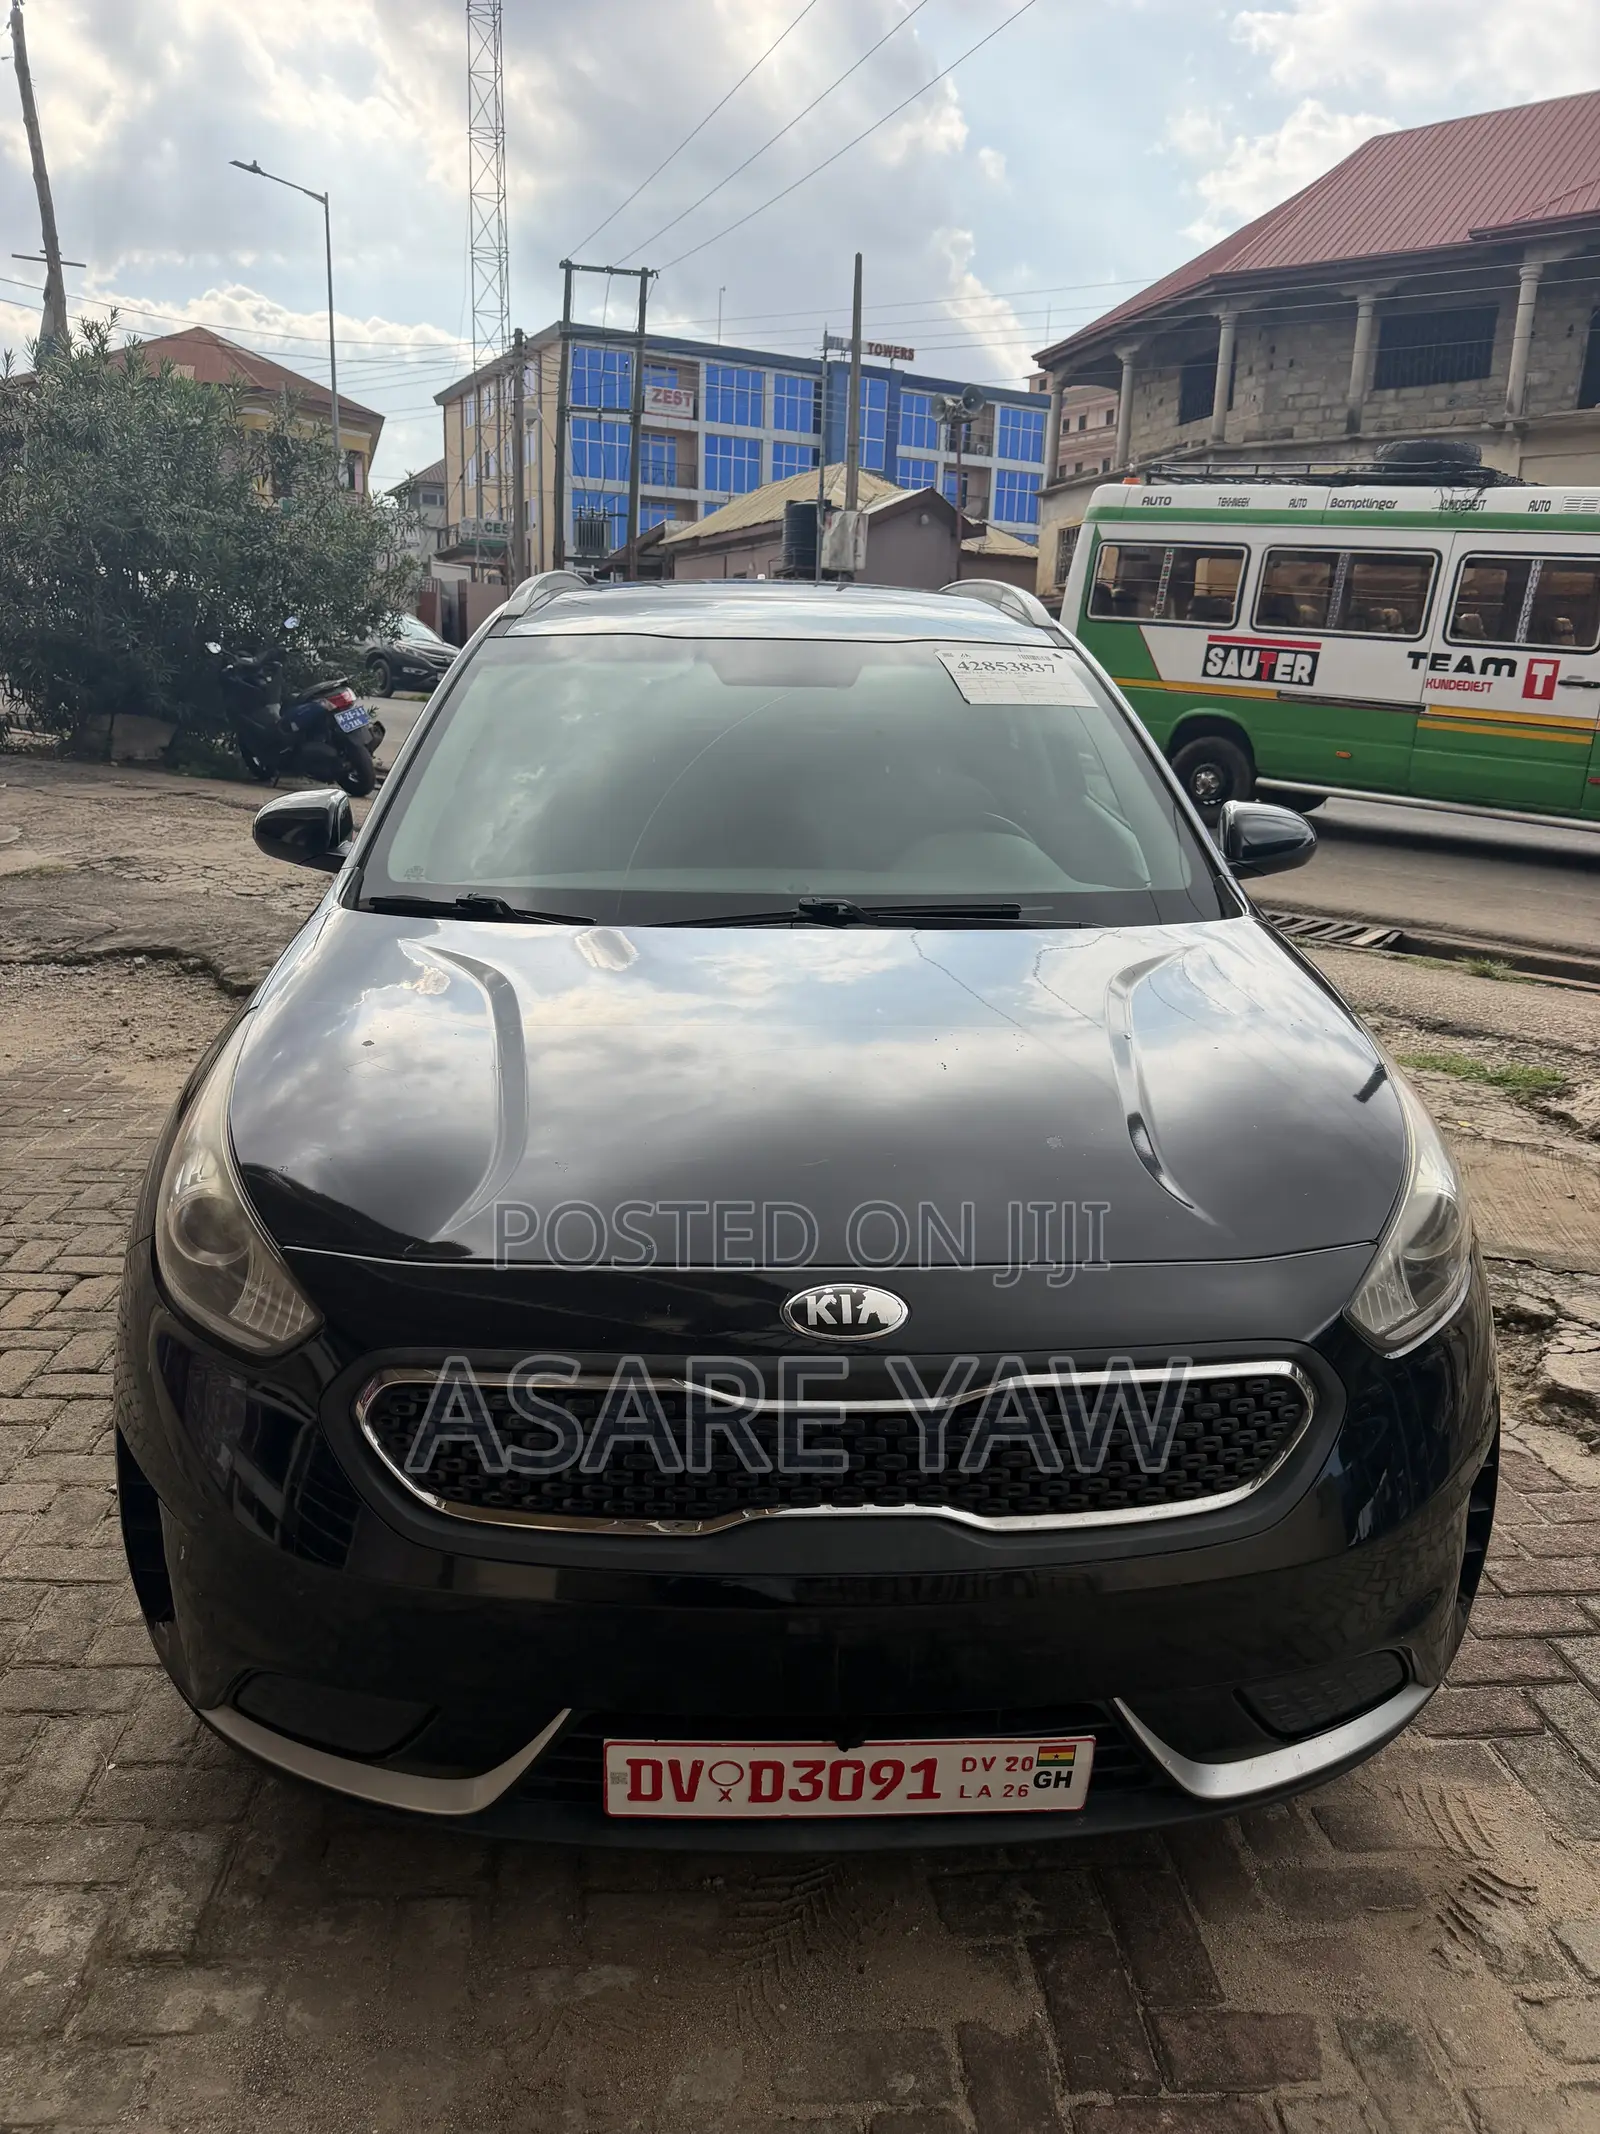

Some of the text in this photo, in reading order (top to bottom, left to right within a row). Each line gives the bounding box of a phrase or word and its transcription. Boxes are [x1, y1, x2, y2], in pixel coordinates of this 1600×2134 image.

[867, 342, 915, 361] TOWERS
[651, 387, 693, 408] ZEST
[1141, 496, 1172, 506] AUTO
[1288, 498, 1308, 508] AUTO
[1528, 500, 1551, 512] AUTO
[957, 660, 1056, 674] 42853837
[1205, 646, 1315, 683] SAUTER
[1407, 651, 1518, 678] TEAM
[805, 1294, 890, 1325] KIA
[961, 1756, 1034, 1773] DV 20
[626, 1758, 704, 1803] DV
[748, 1758, 942, 1804] D3091
[1033, 1770, 1073, 1789] GH
[959, 1784, 1030, 1799] LA 26
